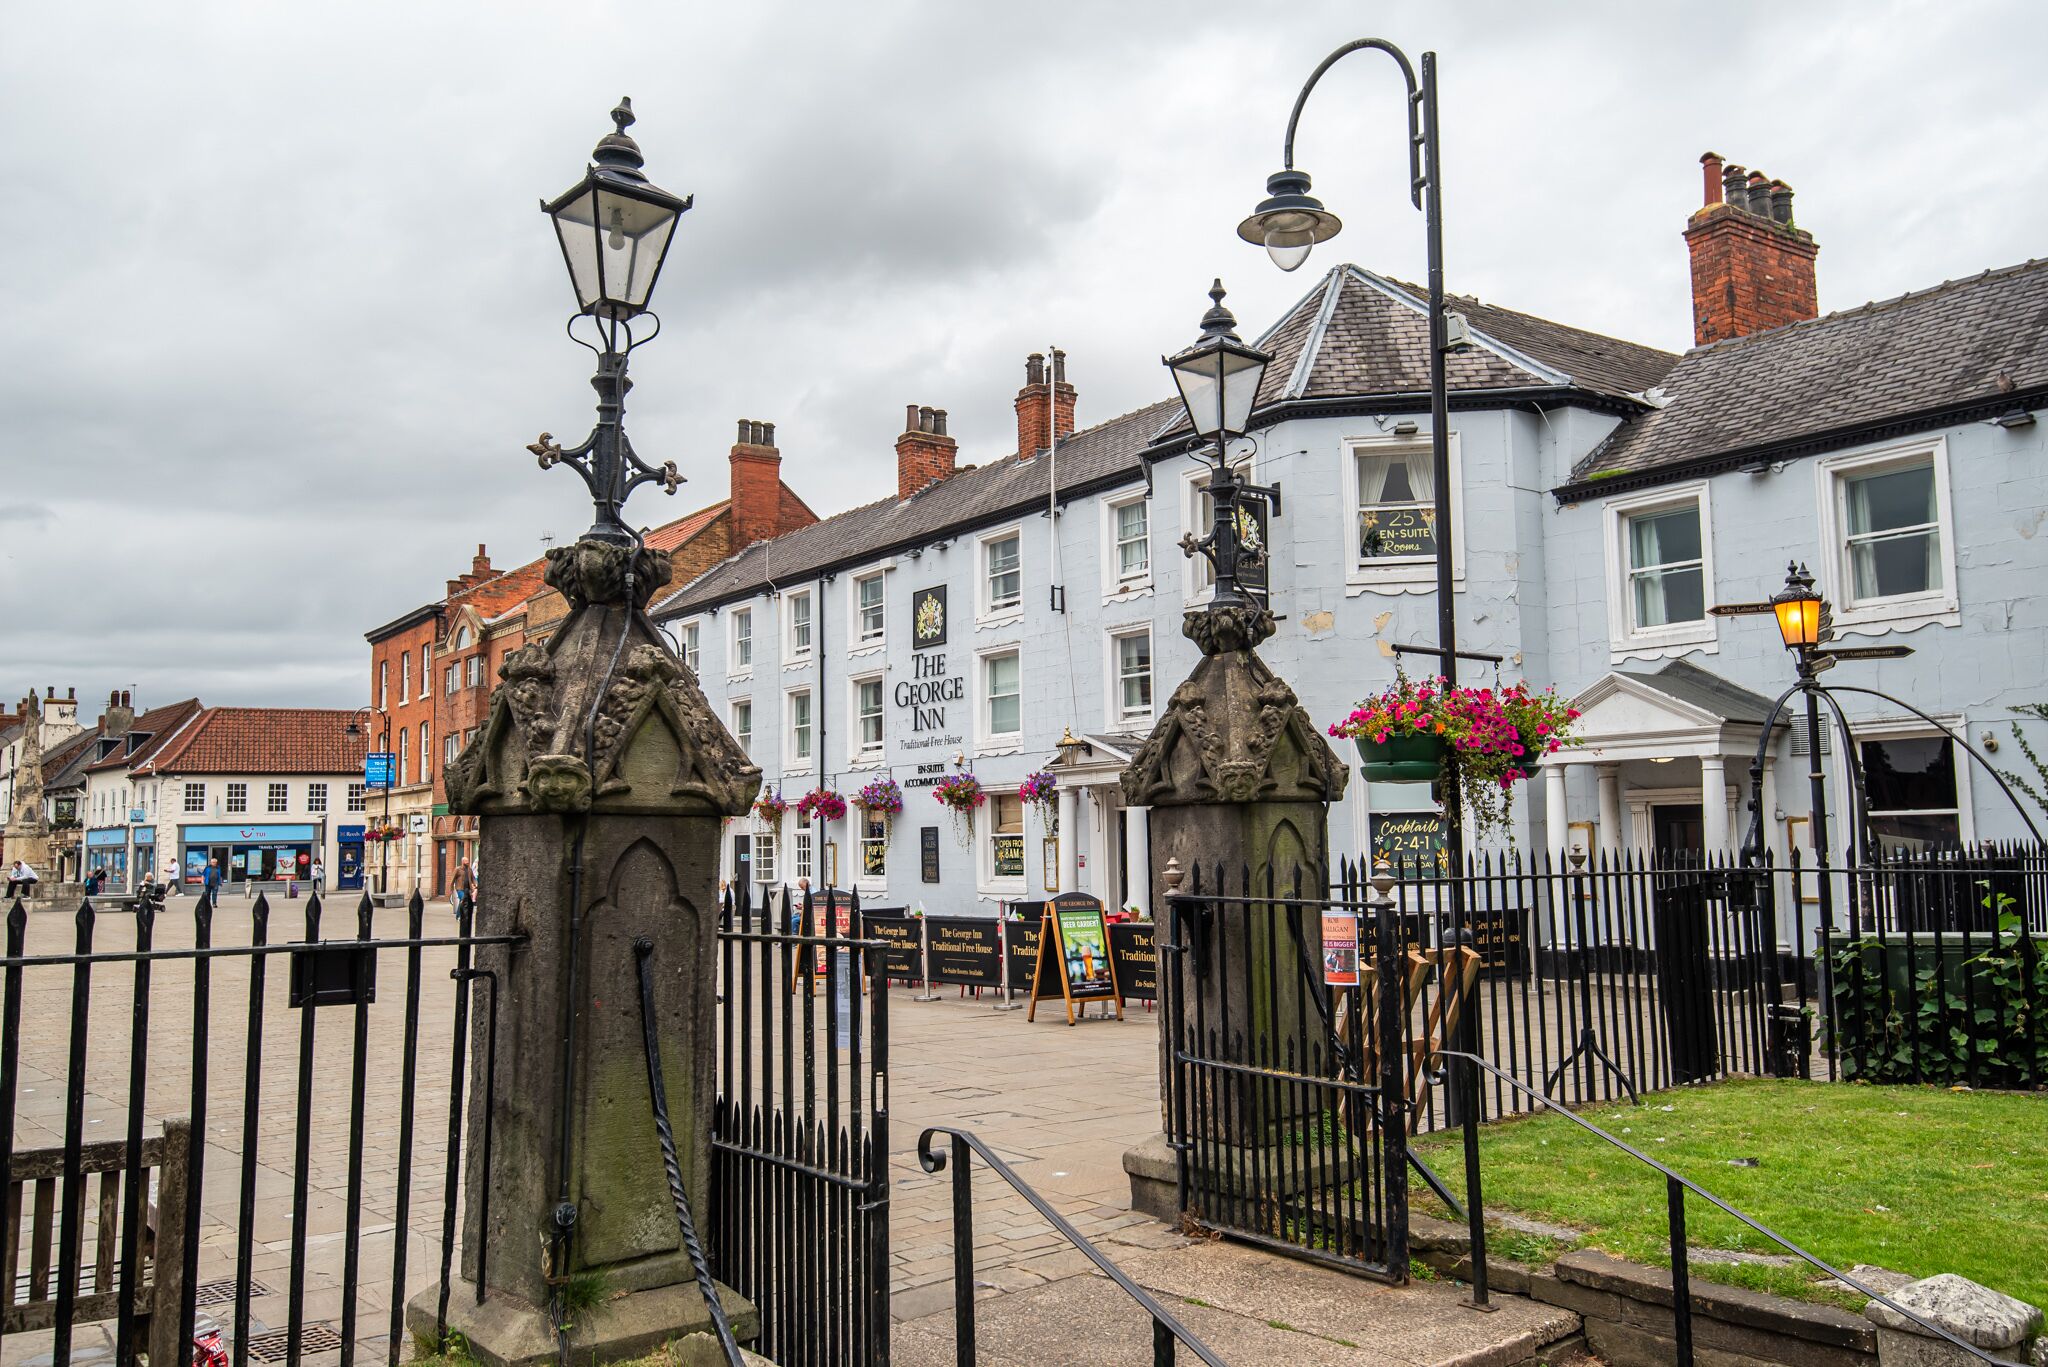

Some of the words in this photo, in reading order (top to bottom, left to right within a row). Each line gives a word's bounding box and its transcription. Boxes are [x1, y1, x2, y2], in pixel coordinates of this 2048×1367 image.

[1389, 511, 1414, 526] 25
[1380, 528, 1430, 539] EN-SUITE
[1383, 540, 1421, 554] Rooms
[912, 653, 946, 679] THE
[895, 676, 964, 708] GEORGE
[912, 706, 945, 731] INN
[900, 737, 930, 750] Traditional
[930, 736, 943, 747] Free
[944, 735, 962, 746] House
[917, 763, 945, 774] EN-SUITE
[1381, 819, 1439, 836] Cocktails
[999, 840, 1012, 848] OPEN
[1394, 835, 1429, 851] 2-4-1
[867, 845, 878, 856] POP
[1005, 849, 1020, 858] 8AM
[1393, 861, 1416, 869] EERY
[874, 925, 883, 935] The
[883, 926, 899, 937] George
[899, 927, 907, 936] Inn
[941, 927, 951, 937] The
[952, 929, 973, 940] George
[973, 929, 983, 939] Inn
[1024, 930, 1037, 942] The
[890, 940, 901, 949] Free
[901, 940, 918, 950] House
[1133, 934, 1149, 946] The
[931, 941, 961, 952] Traditional
[962, 943, 975, 953] Free
[975, 943, 993, 954] House
